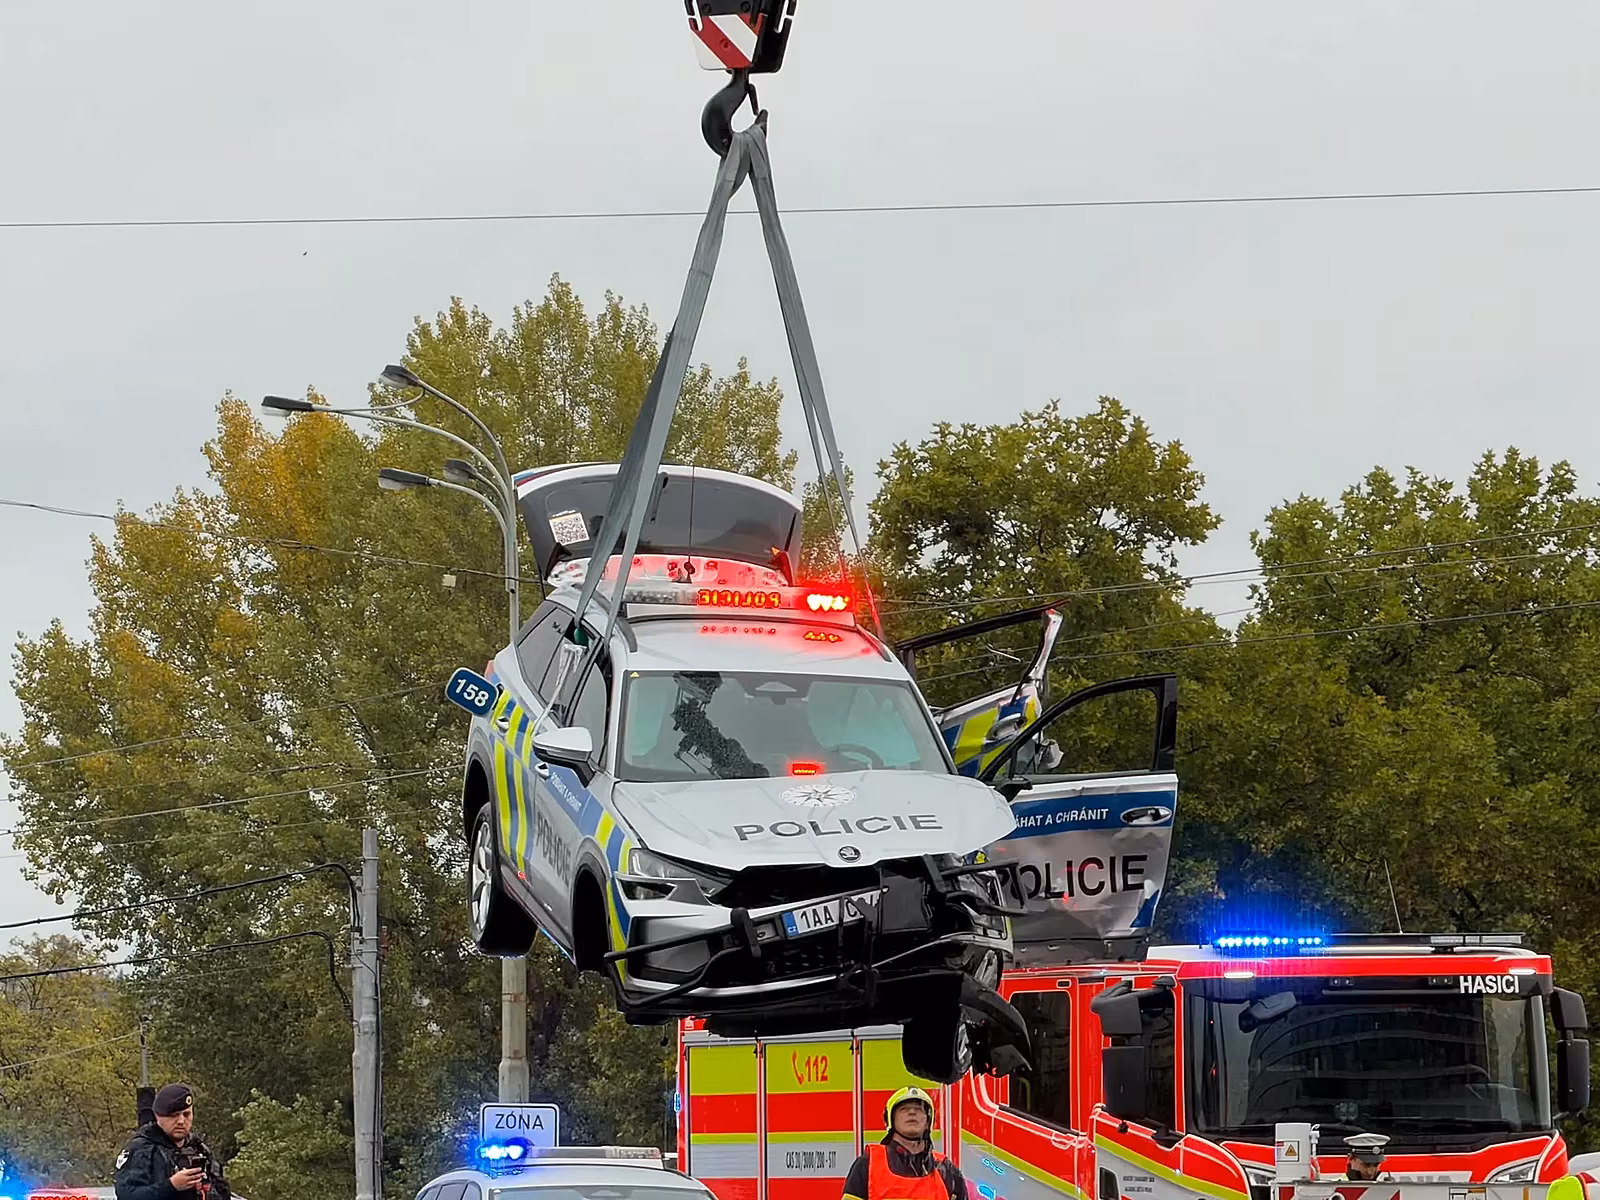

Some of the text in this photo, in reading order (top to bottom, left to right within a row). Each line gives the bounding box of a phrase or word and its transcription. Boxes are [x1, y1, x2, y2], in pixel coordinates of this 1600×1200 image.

[455, 678, 489, 707] 158
[733, 814, 943, 841] POLICIE
[1015, 806, 1109, 828] ÁHAT A CHRÁNIT
[800, 905, 835, 929] 1AA
[805, 1055, 829, 1082] 112
[494, 1110, 545, 1131] ZÓNA
